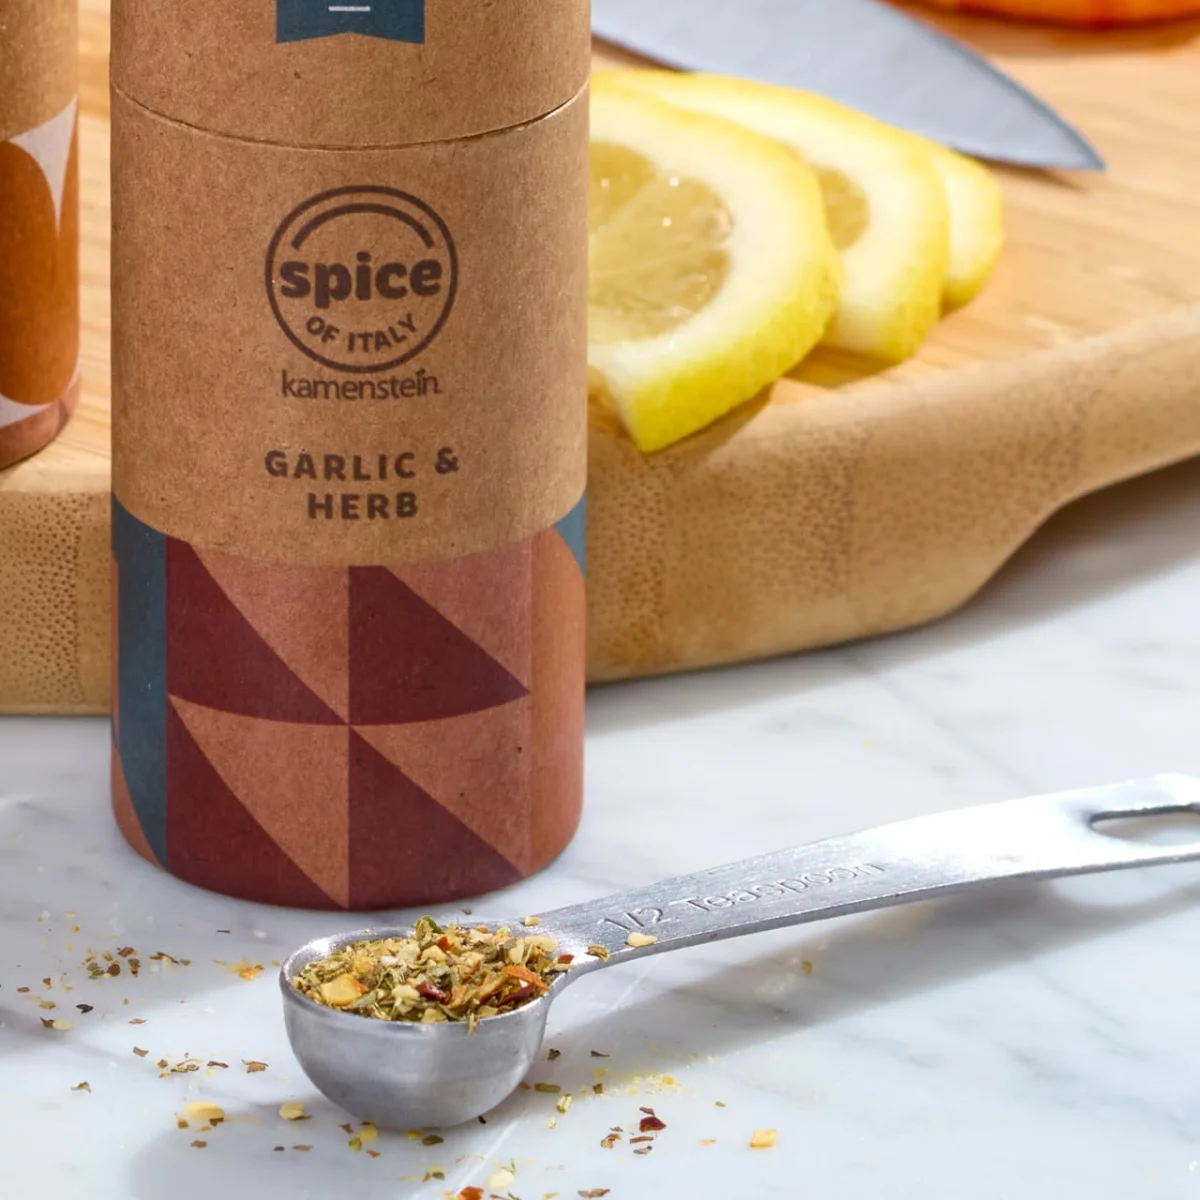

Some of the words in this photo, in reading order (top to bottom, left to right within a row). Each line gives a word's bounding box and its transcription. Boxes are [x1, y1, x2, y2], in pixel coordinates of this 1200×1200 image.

[279, 251, 443, 310] spice
[305, 315, 341, 345] OF
[347, 312, 419, 353] ITALY
[281, 368, 440, 400] kamenstein
[264, 449, 416, 482] GARLIC
[434, 446, 460, 475] &
[307, 491, 418, 521] HERB
[598, 906, 672, 931] 1/2
[668, 862, 887, 912] Teaspoon
